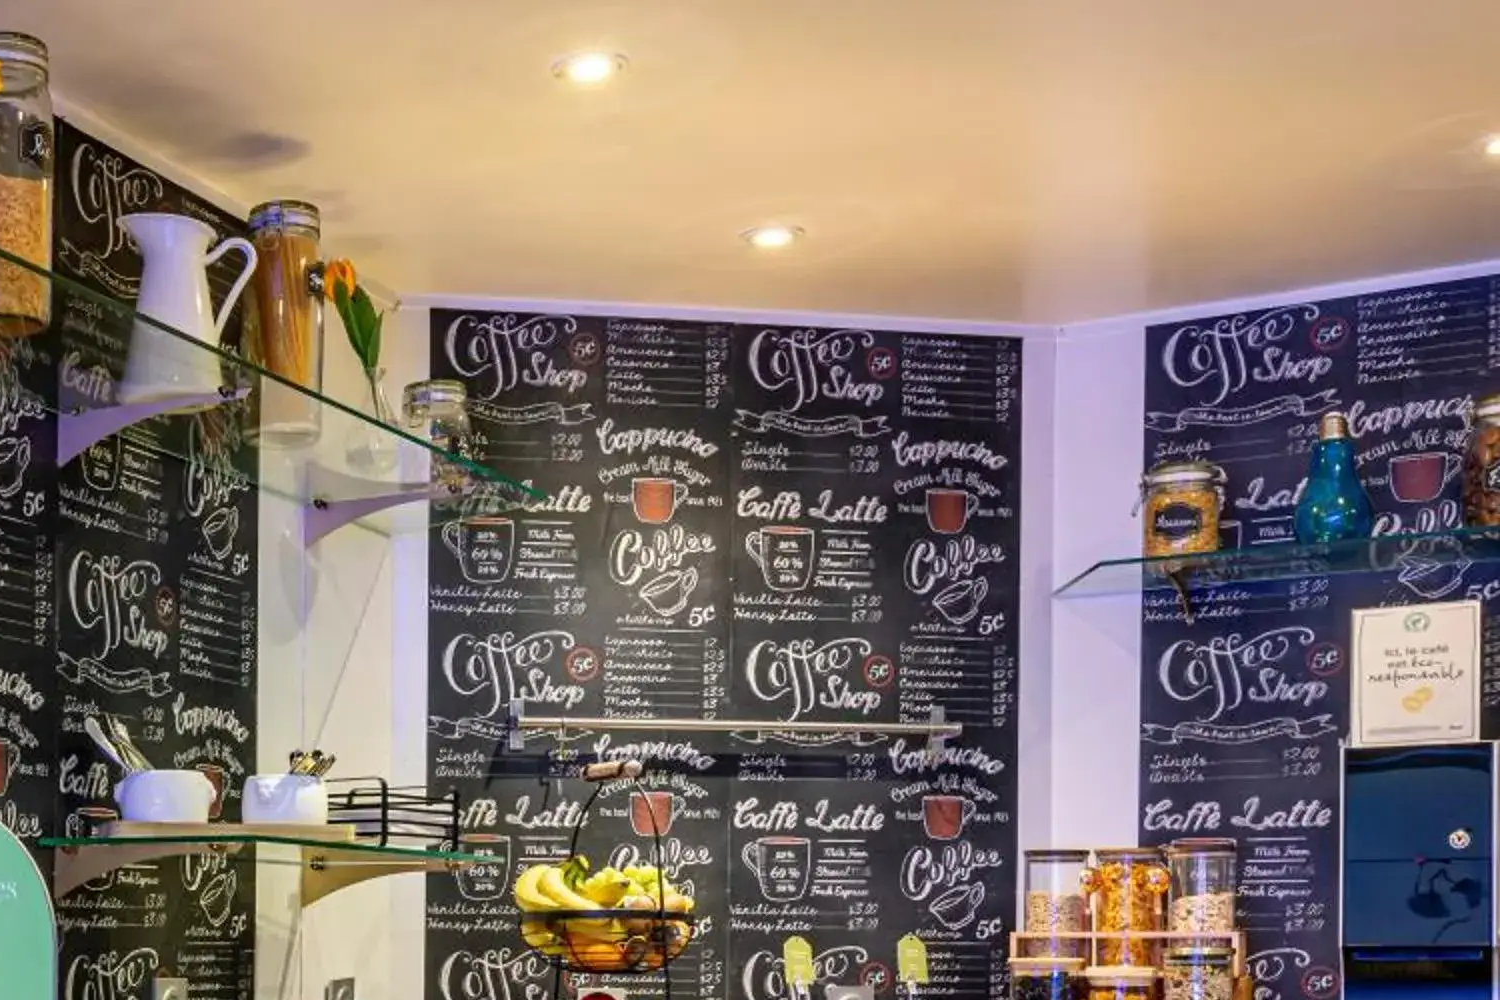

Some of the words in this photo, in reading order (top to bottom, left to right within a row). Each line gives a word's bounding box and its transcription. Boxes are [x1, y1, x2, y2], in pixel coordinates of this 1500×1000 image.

[71, 142, 163, 259] Coffee
[445, 313, 578, 402] Coffee
[522, 350, 588, 393] Shop
[749, 328, 875, 414] Coffee
[1161, 302, 1320, 407] Coffee
[1253, 346, 1333, 383] Shop
[821, 365, 885, 407] Shop
[808, 489, 889, 523] Latte
[608, 523, 717, 586] Coffee
[903, 534, 1006, 594] Coffee
[68, 550, 162, 661] Coffee
[123, 604, 168, 660] Shop
[442, 631, 576, 721] Coffee
[521, 668, 585, 709] Shop
[745, 637, 871, 722] Coffee
[819, 675, 882, 715] Shop
[1158, 626, 1315, 725] Coffee
[1249, 666, 1330, 707] Shop
[505, 795, 591, 830] Latte
[805, 799, 886, 833] Latte
[1230, 796, 1333, 831] Latte
[900, 841, 1002, 901] Coffee
[729, 918, 771, 934] Honey
[771, 918, 813, 932] Latte
[780, 904, 819, 916] Latte
